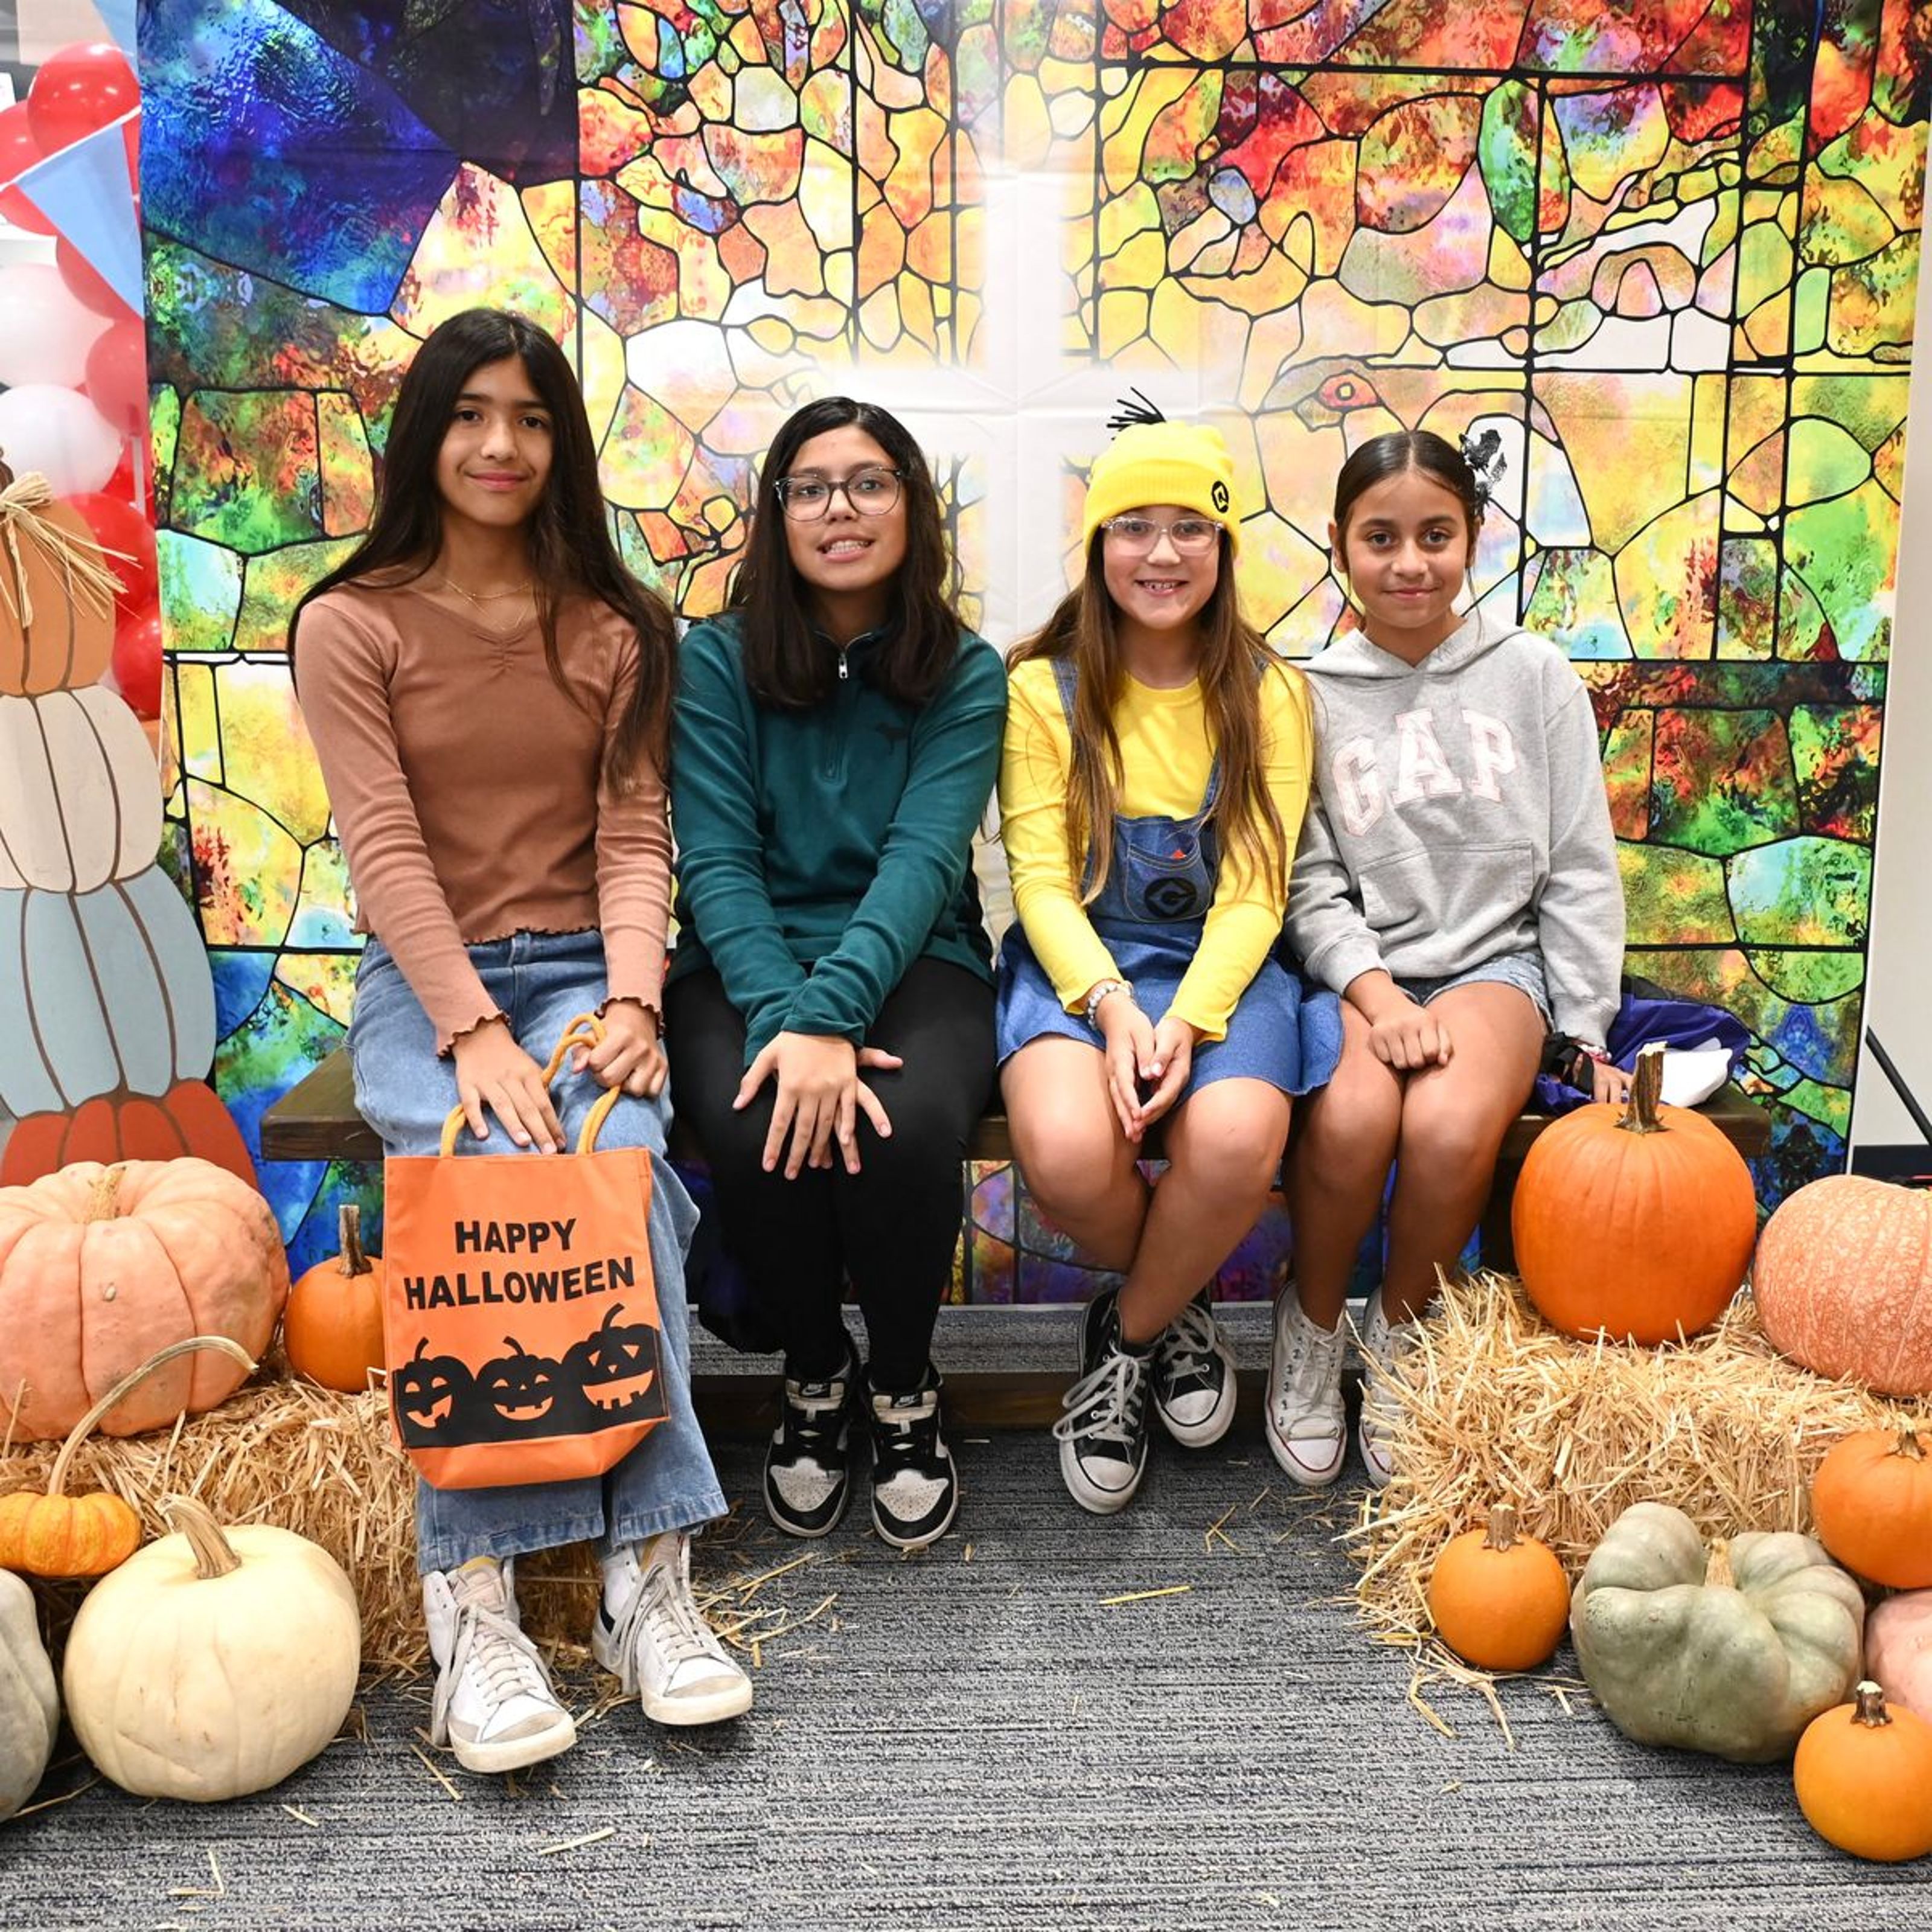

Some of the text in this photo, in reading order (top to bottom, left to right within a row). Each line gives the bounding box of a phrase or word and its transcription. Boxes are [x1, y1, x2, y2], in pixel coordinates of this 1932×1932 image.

[1332, 708, 1517, 836] GAP
[455, 1218, 576, 1253] HAPPY
[404, 1257, 635, 1310] HALLOWEEN
